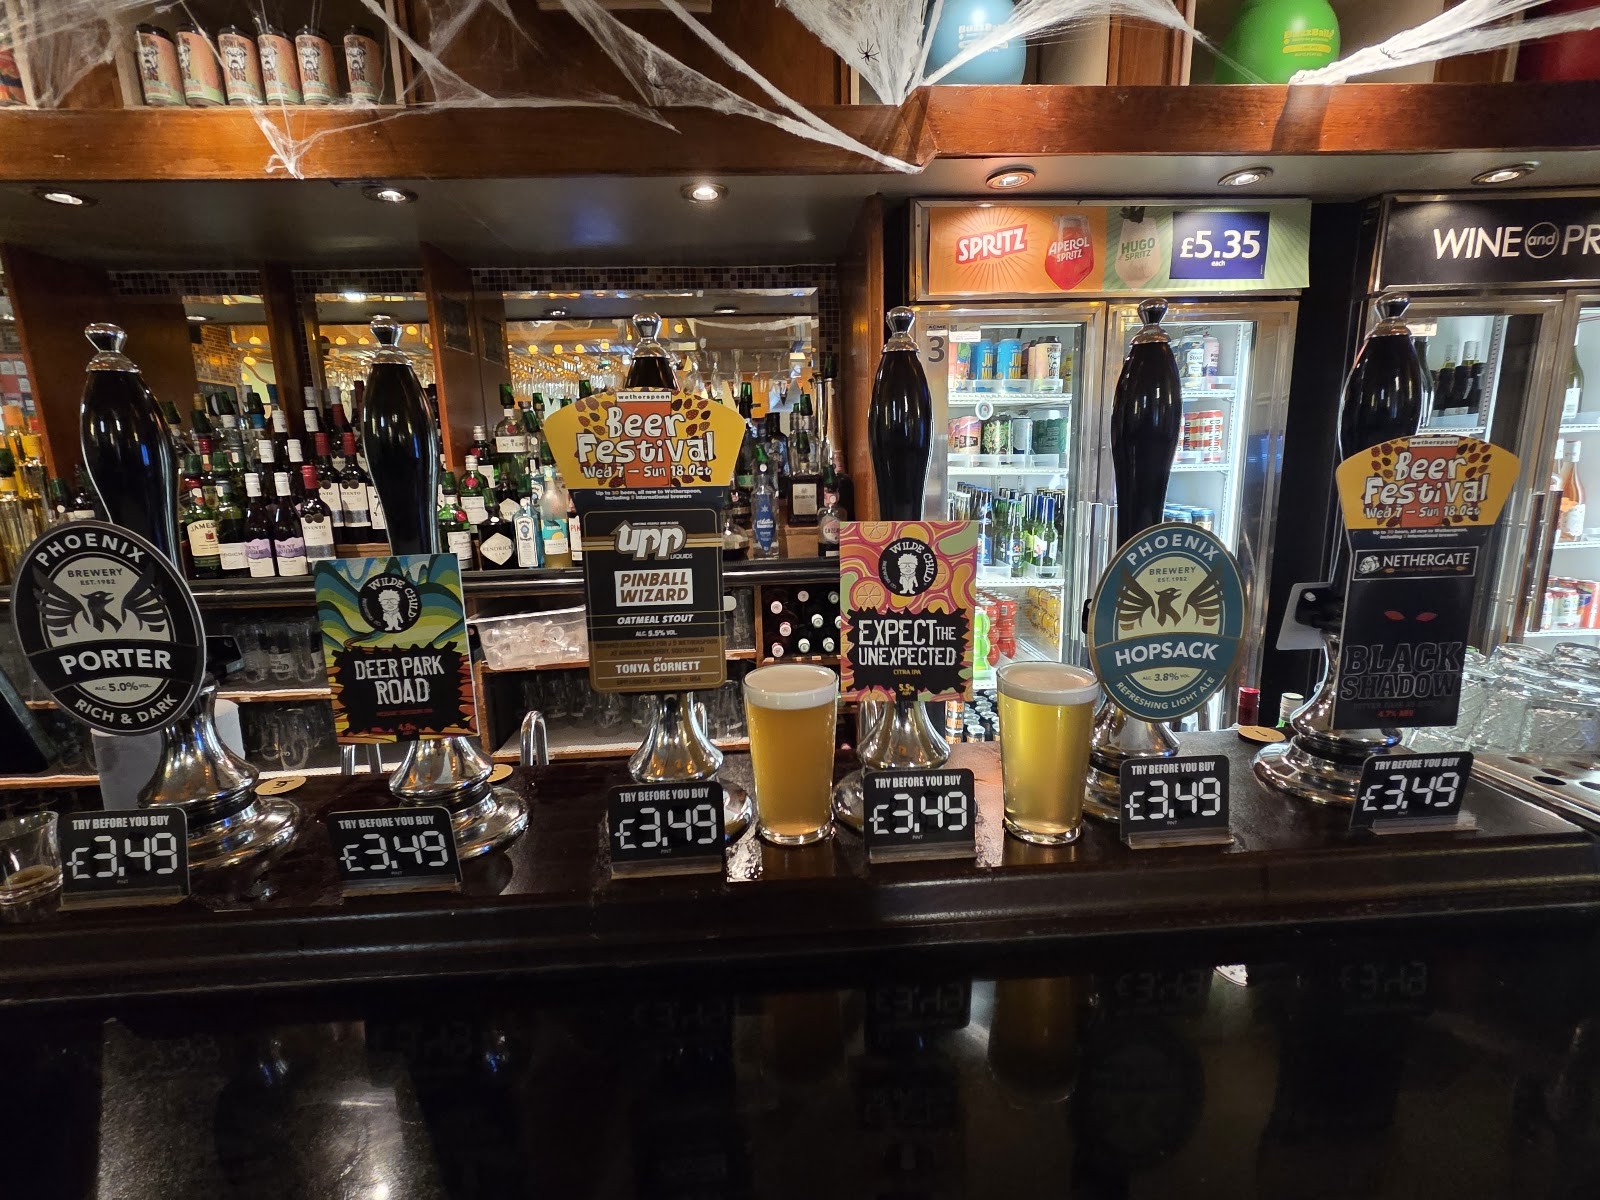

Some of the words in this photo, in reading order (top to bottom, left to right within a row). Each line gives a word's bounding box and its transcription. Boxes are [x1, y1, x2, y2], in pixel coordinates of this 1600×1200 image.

[957, 226, 1025, 261] SPRITZ
[1048, 236, 1090, 257] APEROL
[1121, 237, 1156, 255] HUGO
[1180, 229, 1261, 260] £5.35
[1433, 226, 1523, 260] WINE
[1527, 231, 1556, 246] and
[1561, 223, 1600, 256] PR
[1056, 249, 1083, 263] SPRITZ
[1124, 249, 1152, 262] SPRITZ
[1211, 259, 1226, 267] each
[927, 335, 945, 362] 3
[606, 406, 685, 438] Beer
[576, 431, 715, 464] Festival
[583, 466, 612, 478] Wed
[615, 466, 624, 477] 7
[643, 465, 666, 477] Sun
[670, 465, 683, 476] 18
[688, 464, 712, 476] Oct
[1395, 451, 1468, 481] Beer
[1364, 474, 1489, 505] Festival
[1365, 506, 1392, 519] Wed
[1394, 506, 1403, 517] 7
[1419, 505, 1440, 517] Sun
[1443, 505, 1456, 516] 18
[1459, 504, 1482, 516] Oct
[35, 533, 145, 567] PHOENIX
[889, 541, 925, 554] WILDE
[922, 553, 935, 583] CHILD
[1126, 533, 1220, 566] PHOENIX
[1382, 552, 1471, 567] NETHERGATE
[67, 567, 123, 578] BREWERY
[619, 571, 688, 588] PINBALL
[1149, 566, 1197, 576] BREWERY
[367, 577, 405, 591] WILDE
[404, 588, 419, 621] CHILD
[619, 587, 689, 604] WIZARD
[617, 615, 660, 625] OATMEAL
[662, 614, 694, 623] STOUT
[858, 619, 937, 646] EXPECT
[935, 626, 957, 641] THE
[58, 648, 172, 675] PORTER
[858, 646, 957, 667] UNEXPECTED
[1114, 641, 1220, 667] HOPSACK
[1343, 642, 1463, 676] BLACK
[354, 659, 400, 680] DEER
[401, 655, 445, 678] PARK
[615, 662, 650, 674] TONYA
[653, 661, 700, 673] CORNETT
[1153, 673, 1180, 682] 3.8%
[108, 681, 138, 692] 5.0%
[374, 678, 430, 705] ROAD
[1115, 681, 1169, 710] REFRESHING
[1171, 691, 1199, 708] LIGHT
[1200, 675, 1217, 693] ALE
[1340, 672, 1459, 700] SHADOW
[75, 698, 114, 722] RICH
[120, 713, 133, 725] &
[137, 693, 178, 722] DARK
[1131, 765, 1148, 775] TRY
[1148, 764, 1179, 774] BEFORE
[1180, 763, 1198, 772] YOU
[1199, 761, 1215, 771] BUY
[1374, 761, 1391, 770] TRY
[1391, 760, 1423, 770] BEFORE
[1423, 758, 1441, 768] YOU
[1441, 757, 1460, 767] BUY
[619, 792, 637, 802] TRY
[638, 790, 671, 801] BEFORE
[671, 789, 690, 799] YOU
[691, 787, 709, 798] BUY
[875, 778, 891, 788] TRY
[892, 776, 924, 787] BEFORE
[925, 776, 943, 786] YOU
[944, 775, 961, 785] BUY
[1360, 772, 1460, 811] £3.49
[1124, 777, 1220, 820] £3.49
[72, 819, 92, 830] TRY
[93, 817, 128, 829] BEFORE
[129, 816, 149, 828] YOU
[150, 815, 169, 826] BUY
[338, 820, 357, 829] TRY
[358, 818, 394, 828] BEFORE
[394, 816, 415, 826] YOU
[416, 815, 434, 825] BUY
[868, 791, 967, 834] £3.49
[614, 804, 717, 849] £3.49
[66, 832, 179, 880] £3.49
[340, 830, 449, 871] £3.49
